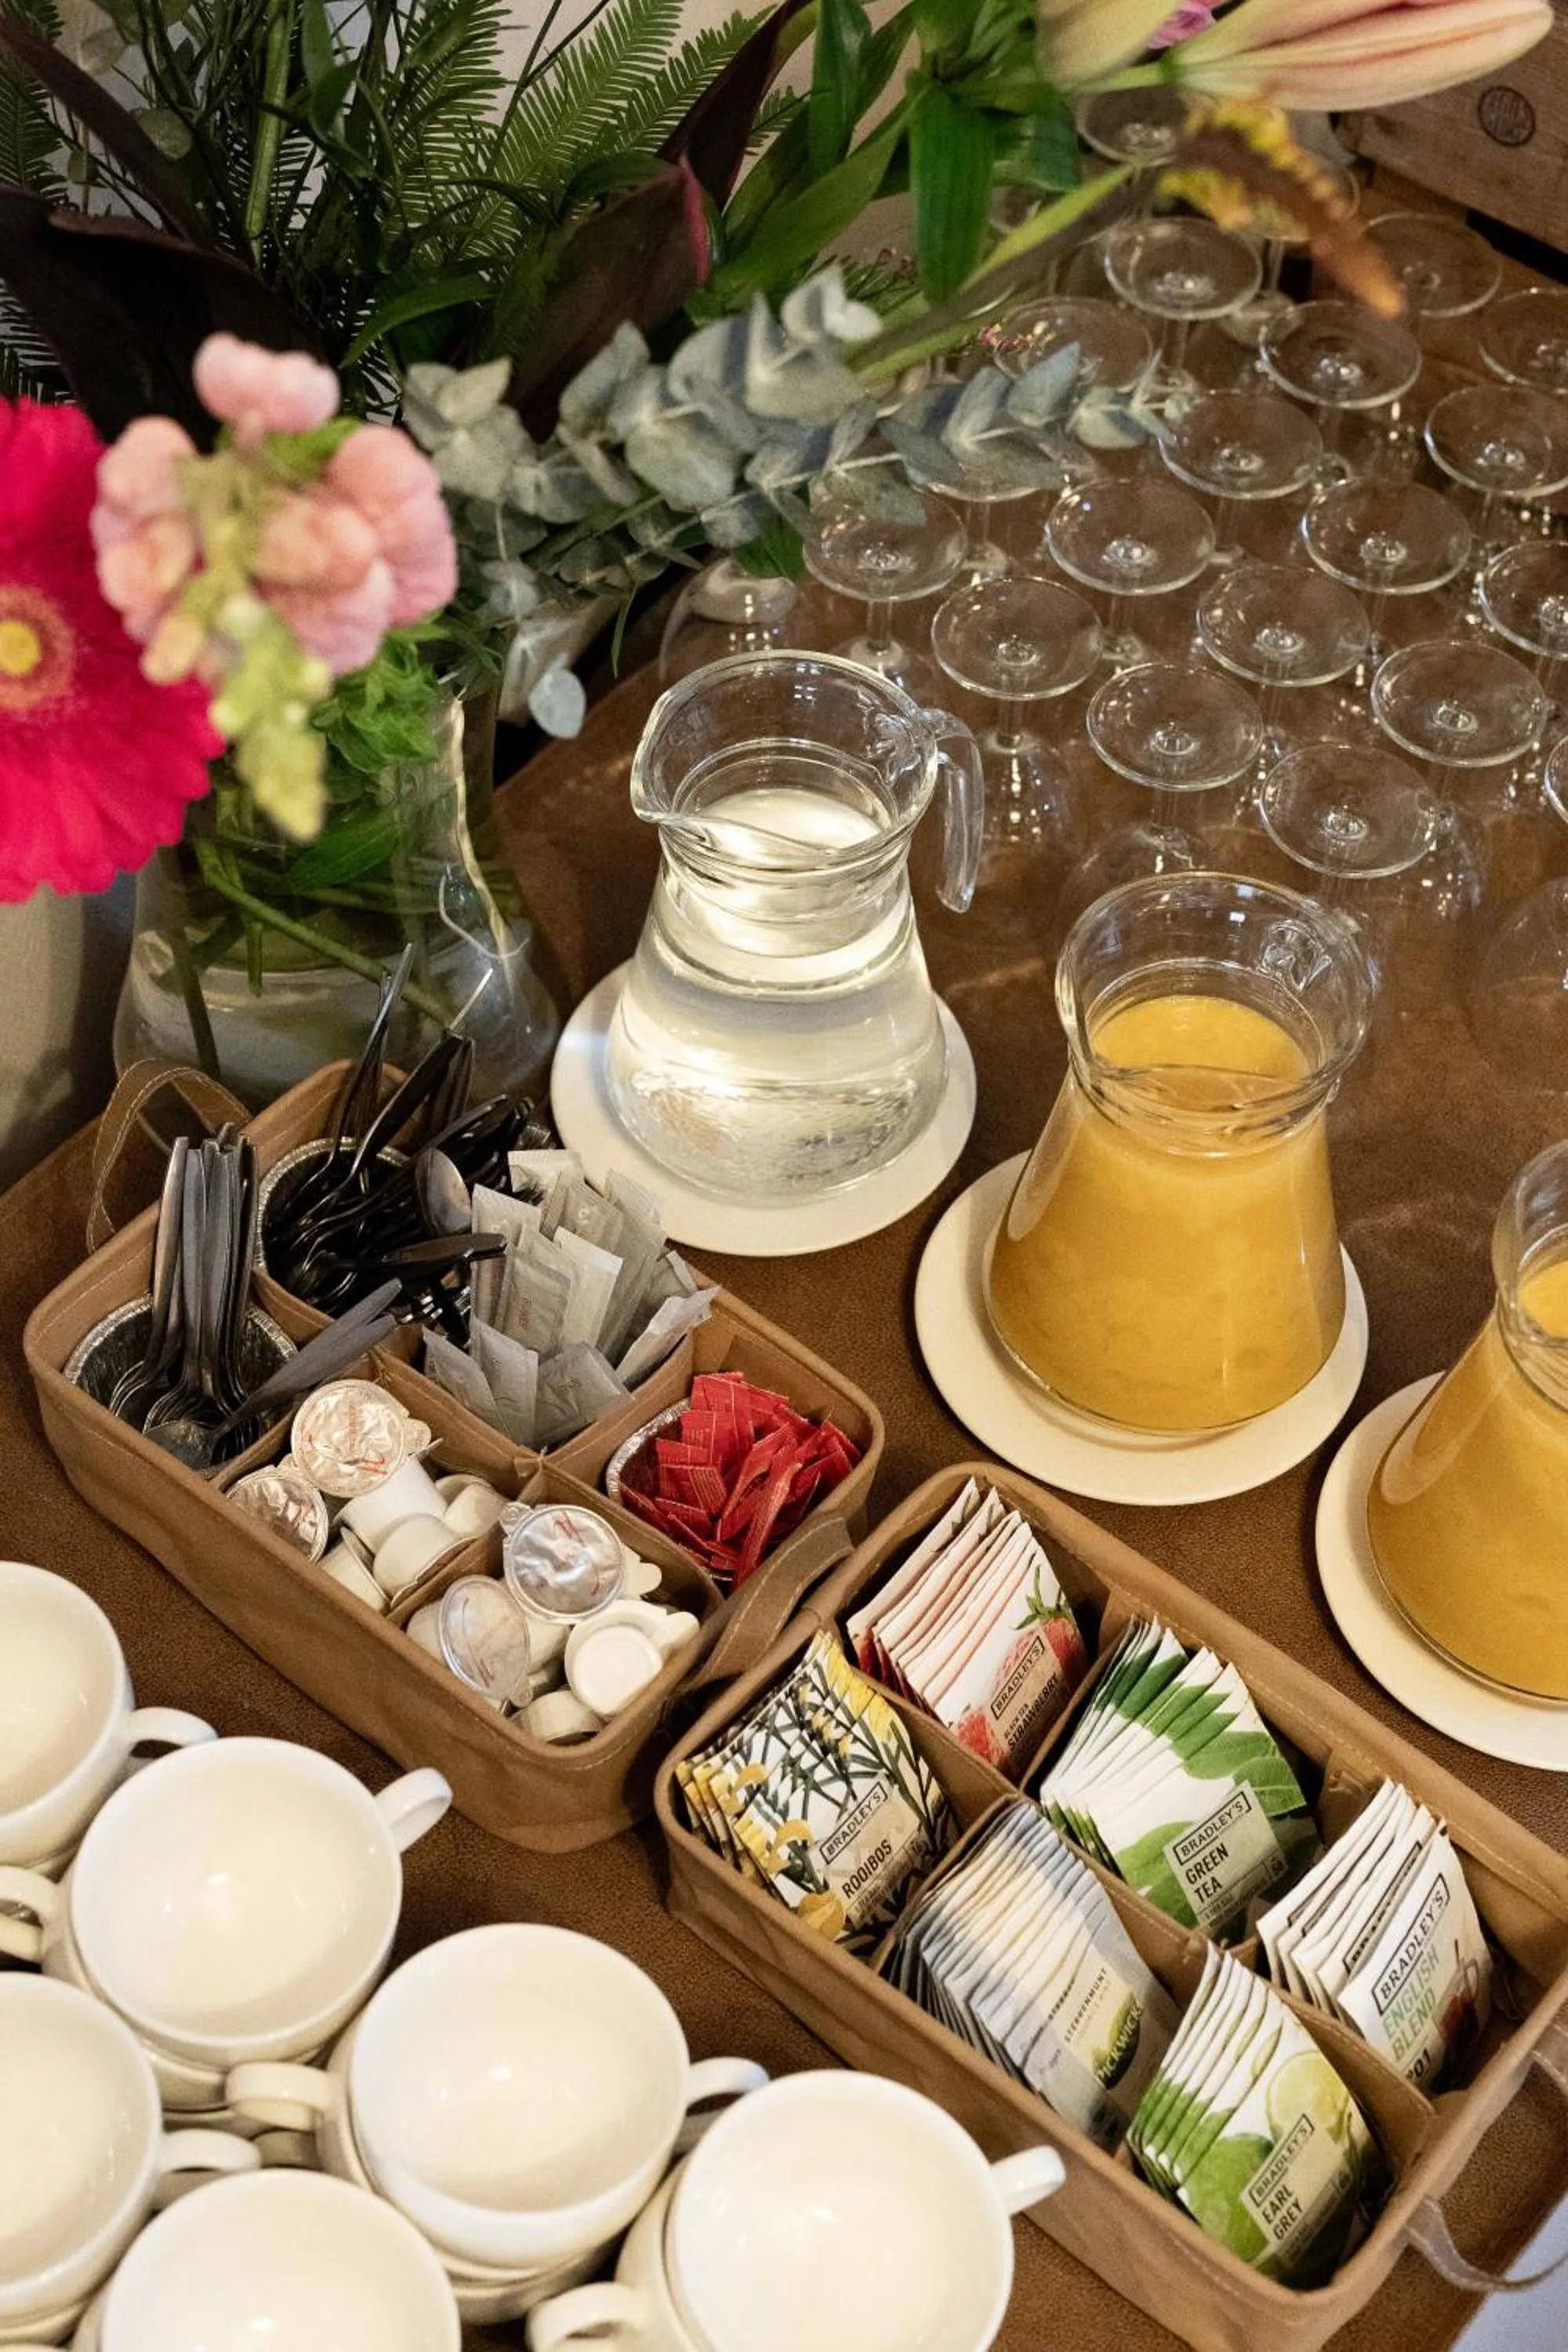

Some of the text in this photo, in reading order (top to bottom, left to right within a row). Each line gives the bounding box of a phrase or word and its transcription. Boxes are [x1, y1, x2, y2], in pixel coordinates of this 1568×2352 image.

[1007, 1671, 1058, 1751] STRAWBERRY
[826, 1791, 881, 1856] BRADLEY'S
[1180, 1801, 1243, 1857] BRADLEY'S
[841, 1839, 892, 1899] ROOIBOS
[1185, 1843, 1229, 1885] GREEN
[1194, 1876, 1222, 1903] TEA
[1380, 1891, 1443, 1999] BRADLEY'S
[1382, 1944, 1440, 2039] ENGLISH
[1093, 2004, 1143, 2090] PICKWICK
[1391, 1986, 1436, 2063] BLEND
[1255, 2125, 1308, 2198] BRADLEY'S
[1261, 2184, 1294, 2225] EARL
[1272, 2198, 1304, 2241] GREY
